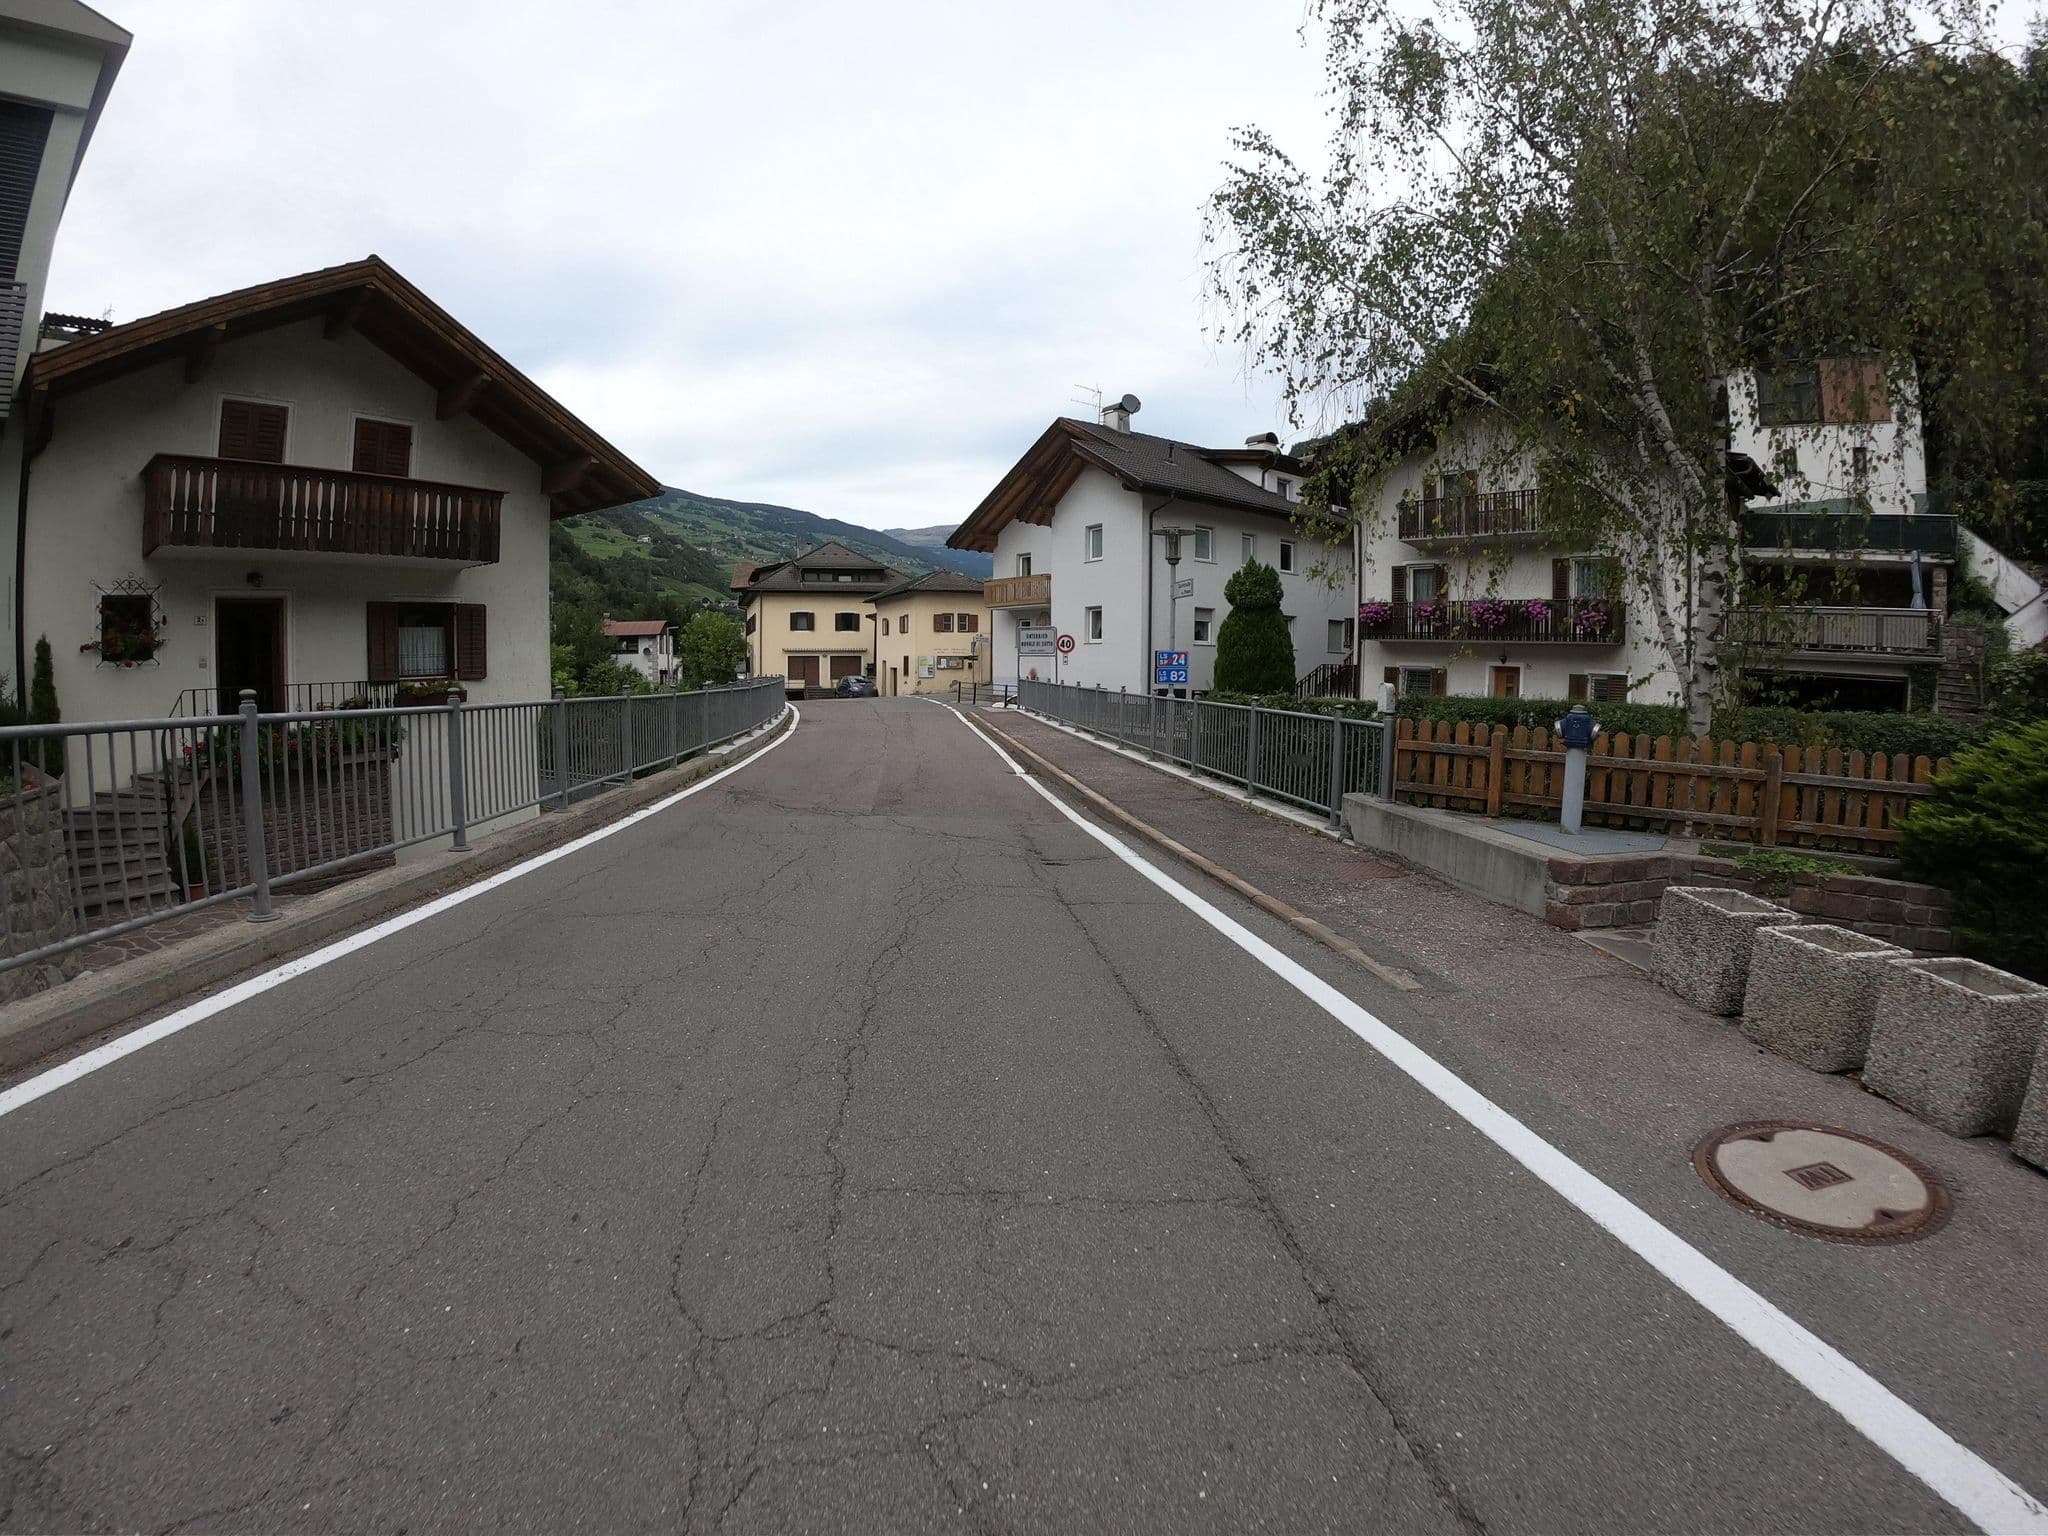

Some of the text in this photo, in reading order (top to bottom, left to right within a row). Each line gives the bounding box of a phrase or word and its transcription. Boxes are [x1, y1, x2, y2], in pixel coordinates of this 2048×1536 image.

[1060, 639, 1071, 648] 40
[1172, 654, 1185, 665] 24
[1170, 670, 1186, 681] 82
